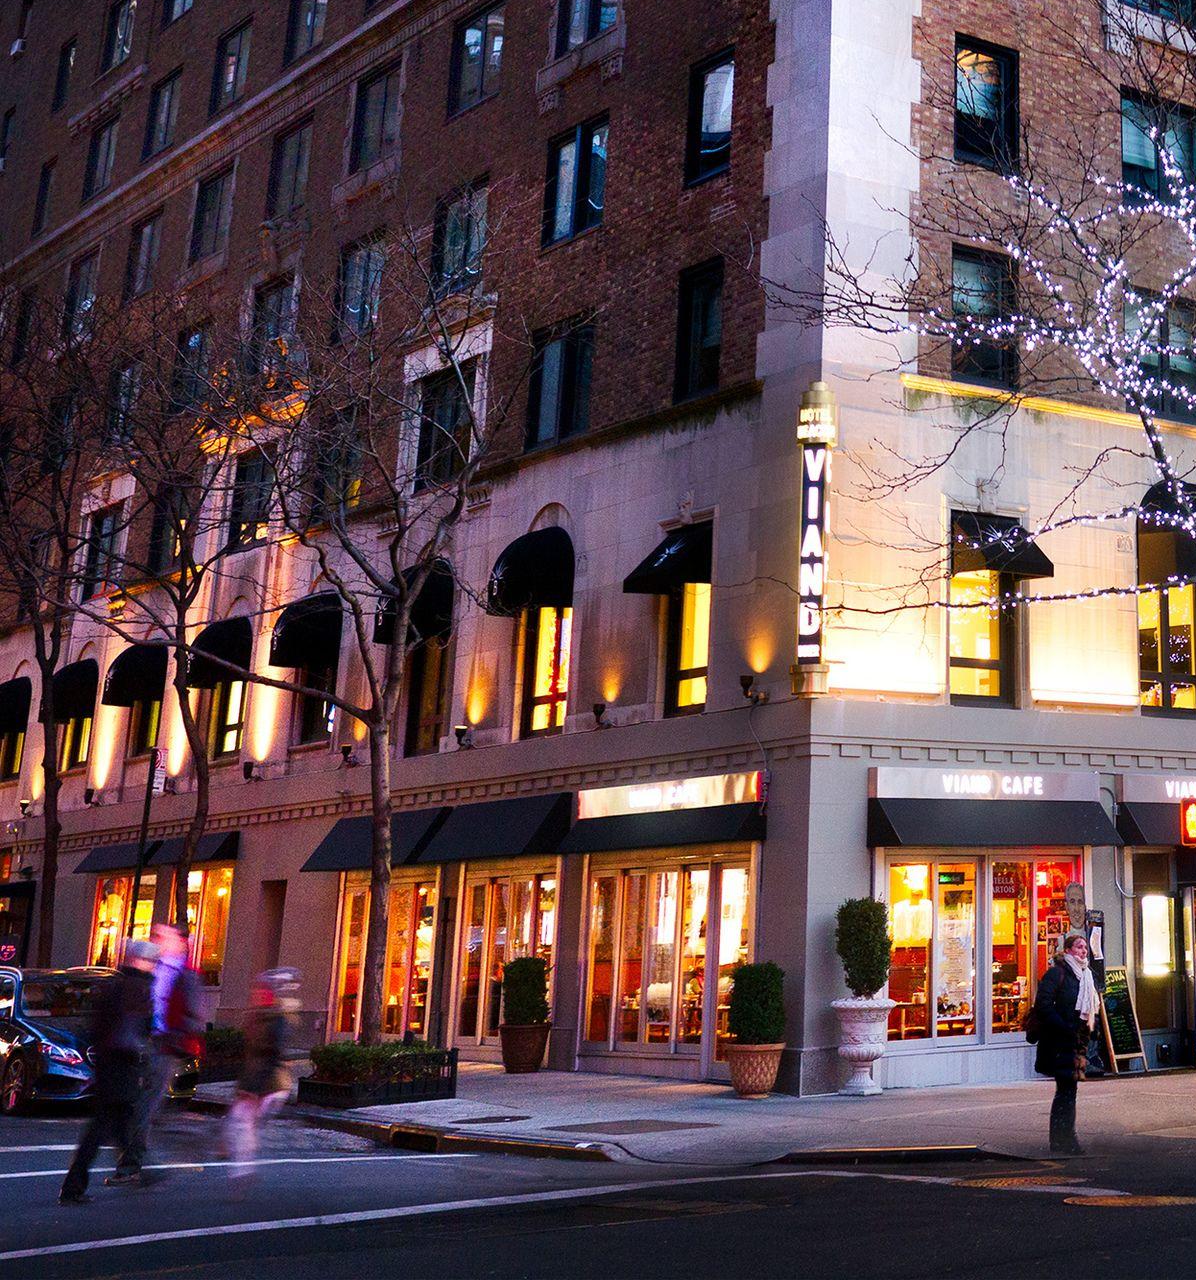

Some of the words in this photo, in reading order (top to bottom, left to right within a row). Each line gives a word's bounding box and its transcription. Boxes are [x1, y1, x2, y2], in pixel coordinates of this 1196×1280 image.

[798, 449, 825, 636] VIAND
[942, 774, 992, 794] VIAND
[1001, 775, 1044, 795] CAFE
[992, 877, 1015, 885] TELLA
[992, 885, 1015, 894] ARTOIS
